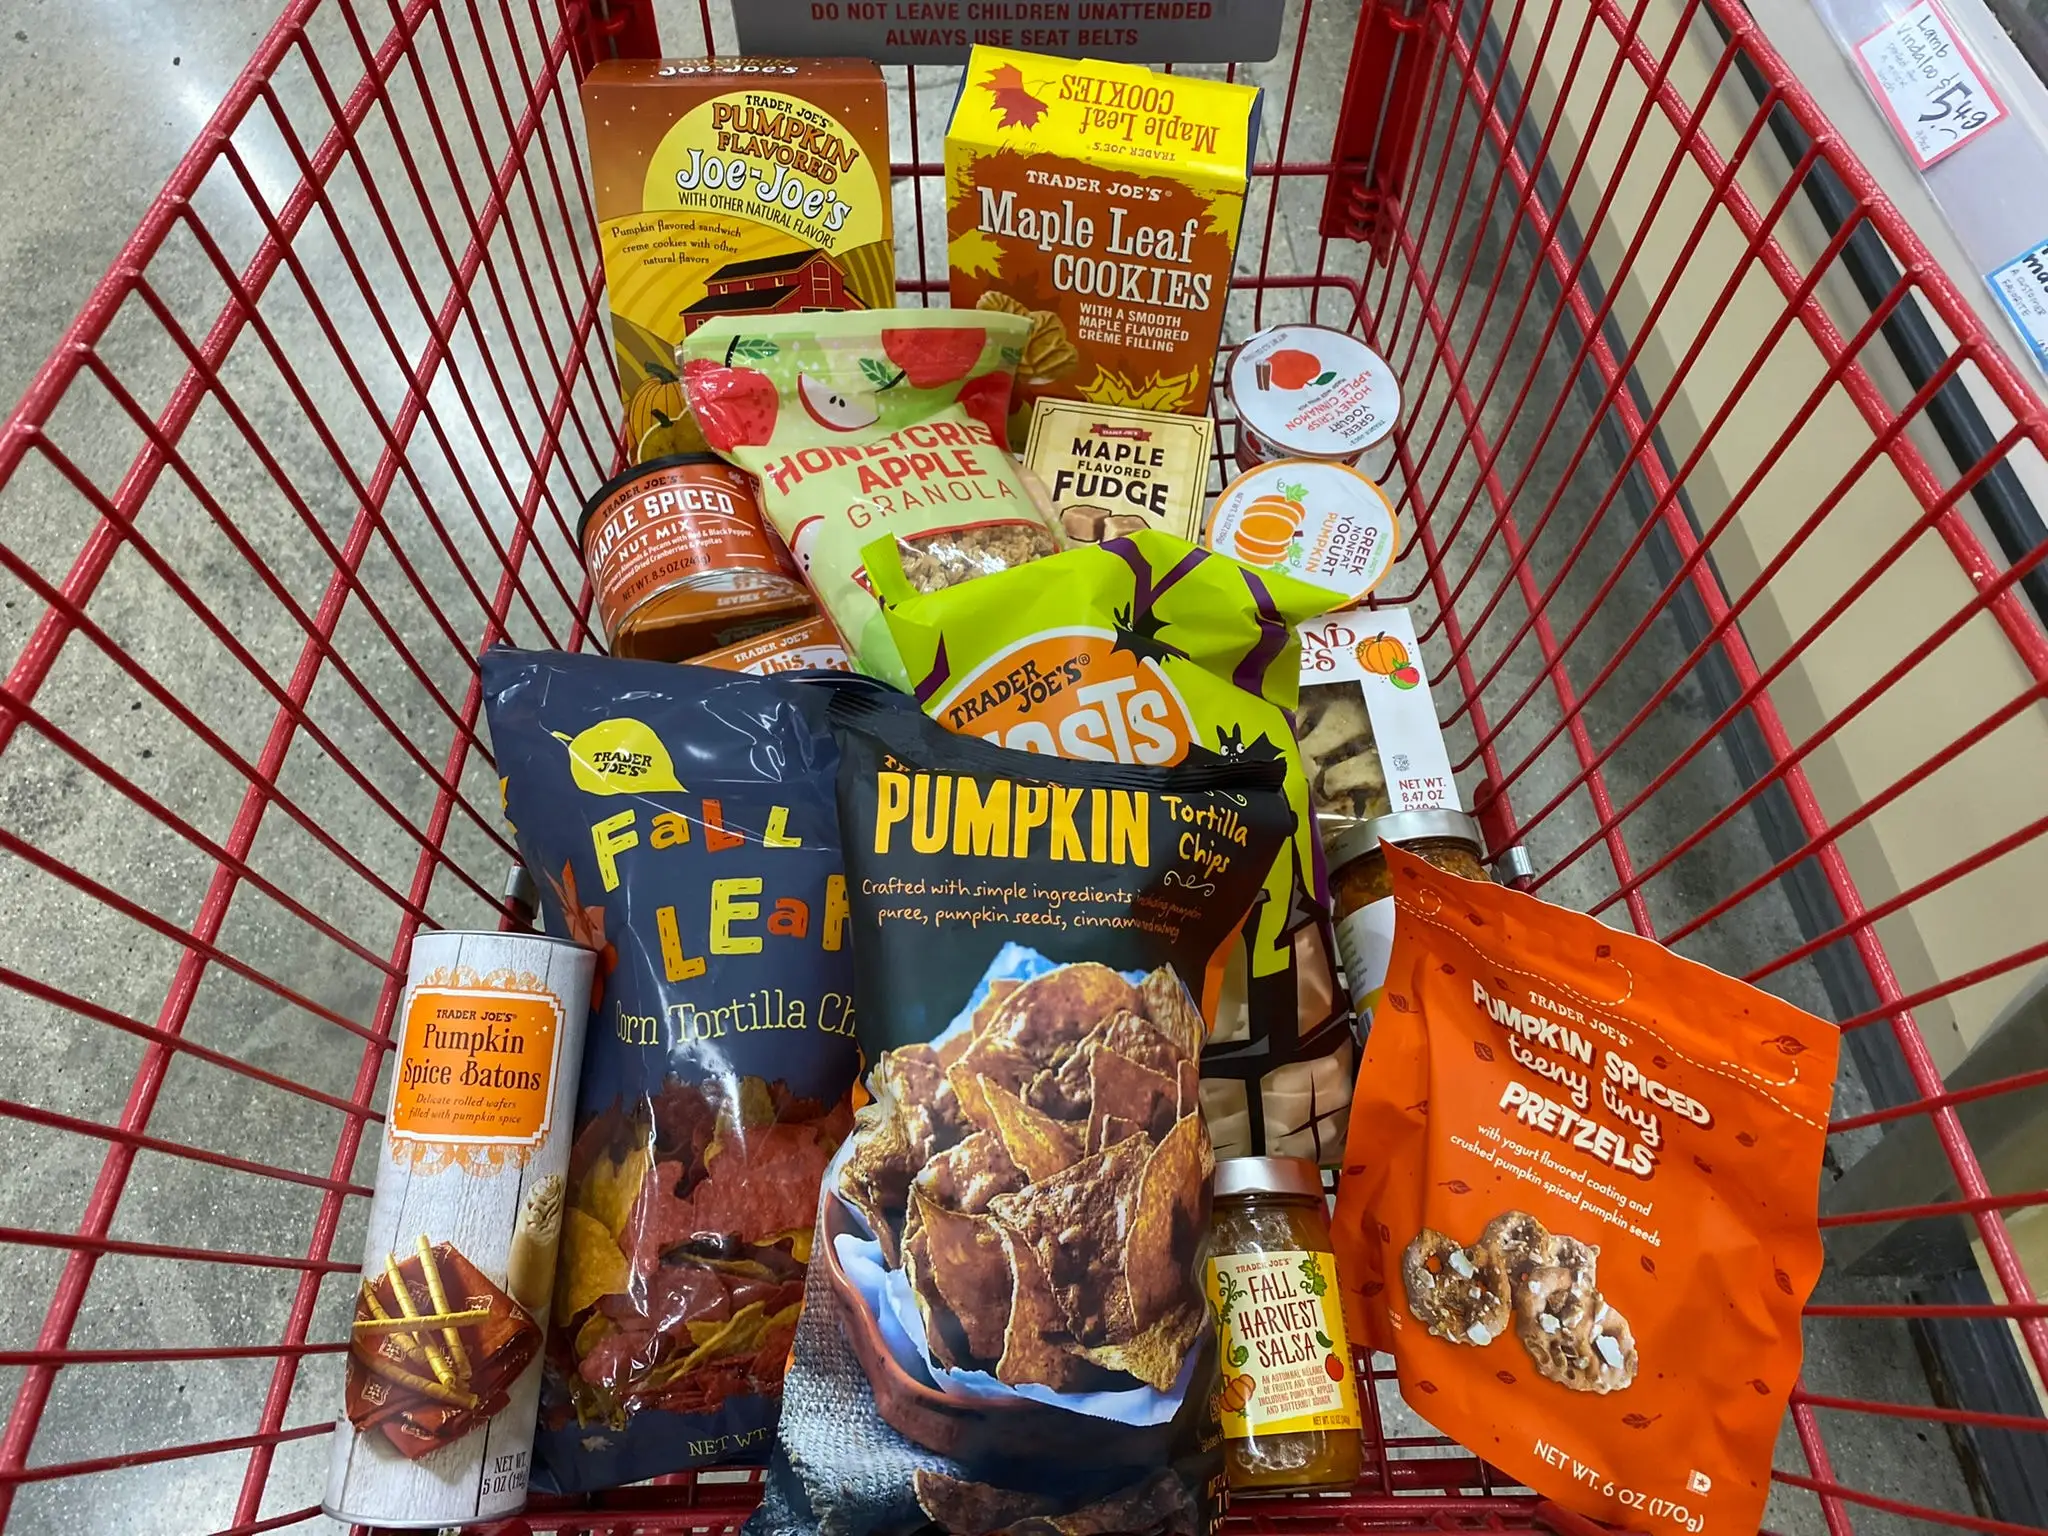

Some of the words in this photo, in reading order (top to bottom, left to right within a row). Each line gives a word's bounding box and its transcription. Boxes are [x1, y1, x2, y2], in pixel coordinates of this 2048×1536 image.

[811, 2, 839, 20] DO
[847, 2, 886, 20] NOT
[895, 2, 960, 20] LEAVE
[967, 2, 1071, 20] CHILDREN
[1077, 2, 1213, 20] UNATTENDED
[886, 29, 967, 46] ALWAYS
[974, 29, 1012, 46] USE
[1020, 29, 1069, 46] SEAT
[1077, 28, 1138, 46] BELTS
[1897, 23, 1939, 80] Vindaloo
[1917, 14, 1949, 59] Lamb
[745, 95, 793, 114] TRADER
[796, 107, 830, 128] JOE'S
[1059, 74, 1175, 115] COOKIES
[712, 102, 858, 173] PUMPKIN
[1079, 106, 1139, 142] Leaf
[1145, 116, 1221, 155] Maple
[717, 132, 838, 185] FLAVORED
[1130, 147, 1176, 162] TRADER
[675, 147, 852, 232] Joe-Joe's
[1026, 169, 1101, 193] TRADER
[1106, 182, 1164, 201] JOE'S
[611, 223, 656, 238] Pumpkin
[657, 219, 696, 232] flavored
[698, 223, 742, 238] sandwich
[678, 191, 707, 207] WITH
[709, 195, 744, 213] OTHER
[746, 202, 792, 227] NATURAL
[793, 217, 837, 249] FLAVORS
[976, 185, 1095, 252] Maple
[1106, 207, 1199, 263] Leaf
[622, 243, 649, 254] creme
[653, 238, 687, 250] cookies
[690, 238, 711, 250] with
[714, 239, 738, 254] other
[643, 254, 676, 265] natural
[679, 252, 710, 265] flavors
[1053, 253, 1213, 312] COOKIES
[2002, 278, 2032, 317] FAVORITE
[1079, 302, 1113, 318] WITH
[1116, 309, 1125, 320] A
[1128, 310, 1182, 328] SMOOTH
[1079, 315, 1121, 332] MAPLE
[1125, 323, 1190, 342] FLAVORED
[1125, 336, 1174, 353] FILLING
[1334, 386, 1373, 418] HONEY
[1337, 370, 1373, 399] APPLE
[1285, 397, 1340, 432] CINNAMON
[1307, 408, 1336, 432] CRISP
[1329, 404, 1371, 433] YOGURT
[1340, 413, 1376, 440] GREEK
[1071, 437, 1165, 467] MAPLE
[1077, 460, 1151, 479] FLAVORED
[856, 449, 988, 494] APPLE
[603, 485, 640, 518] TRADER
[847, 478, 1018, 529] GRANOLA
[1052, 470, 1169, 518] FUDGE
[591, 505, 639, 572] MAPLE
[643, 489, 735, 519] SPICED
[618, 534, 649, 562] NUT
[656, 520, 693, 540] MIX
[648, 539, 672, 555] Pecans
[672, 533, 689, 545] with
[709, 528, 728, 537] Black
[1304, 512, 1338, 573] PUMPKIN
[1321, 516, 1355, 577] YOGURT
[1339, 525, 1363, 570] NONFAT
[650, 545, 688, 564] Cranberries
[696, 537, 723, 548] Pepitas
[1349, 526, 1378, 577] GREEK
[623, 586, 635, 601] NET
[652, 566, 666, 581] 8.5
[667, 560, 679, 572] OZ
[733, 642, 777, 663] TRADER
[780, 630, 810, 647] JOE'S
[948, 660, 1043, 731] TRADER
[1017, 657, 1080, 713] JOE'S
[592, 751, 653, 768] TRADER
[597, 762, 641, 778] JOE'S
[1398, 778, 1420, 790] NET
[1424, 777, 1446, 788] WT.
[1402, 791, 1424, 802] 8.47
[1428, 790, 1445, 800] OZ
[874, 771, 1150, 867] PUMPKIN
[1160, 795, 1249, 848] Tortilla
[1179, 833, 1231, 878] Chips
[862, 877, 926, 895] Crafted
[931, 878, 970, 896] with
[975, 880, 1028, 904] simple
[1033, 884, 1133, 908] ingredients
[877, 907, 929, 926] puree,
[935, 906, 1009, 928] pumpkin
[1012, 910, 1067, 931] seeds,
[436, 1009, 477, 1021] TRADER
[480, 1011, 514, 1023] JOE'S
[616, 1001, 660, 1045] Corn
[668, 988, 807, 1043] Tortilla
[1529, 990, 1586, 1025] TRADER
[1589, 1018, 1629, 1048] JOE'S
[423, 1023, 525, 1058] Pumpkin
[1472, 979, 1595, 1068] PUMPKIN
[1604, 1050, 1713, 1127] SPICED
[403, 1057, 452, 1090] Spice
[460, 1060, 541, 1091] Batons
[416, 1093, 450, 1105] Delicate
[453, 1096, 484, 1107] rolled
[486, 1098, 516, 1111] wafers
[1508, 1034, 1590, 1110] teeny
[1600, 1077, 1662, 1150] tiny
[408, 1109, 430, 1120] filled
[431, 1110, 450, 1120] with
[452, 1111, 495, 1125] pumpkin
[498, 1114, 522, 1125] spice
[1498, 1081, 1658, 1179] PRETZELS
[1477, 1124, 1501, 1143] with
[1502, 1133, 1539, 1161] yogurt
[1540, 1151, 1588, 1184] flavored
[1586, 1176, 1628, 1208] coating
[1629, 1196, 1653, 1217] and
[1450, 1134, 1497, 1162] crushed
[1494, 1155, 1543, 1185] pumpkin
[1543, 1177, 1581, 1206] spiced
[1579, 1193, 1629, 1230] pumpkin
[1629, 1217, 1662, 1248] seeds
[1248, 1271, 1298, 1304] FALL
[1238, 1299, 1319, 1341] HARVEST
[1257, 1332, 1318, 1368] SALSA
[688, 1434, 730, 1457] NET
[494, 1455, 514, 1474] NET
[482, 1478, 491, 1496] 5
[493, 1475, 507, 1494] OZ
[1533, 1439, 1570, 1470] NET
[1572, 1459, 1600, 1490] WT.
[1602, 1481, 1615, 1498] 6
[1618, 1489, 1648, 1510] OZ
[1648, 1498, 1705, 1533] (170g)
